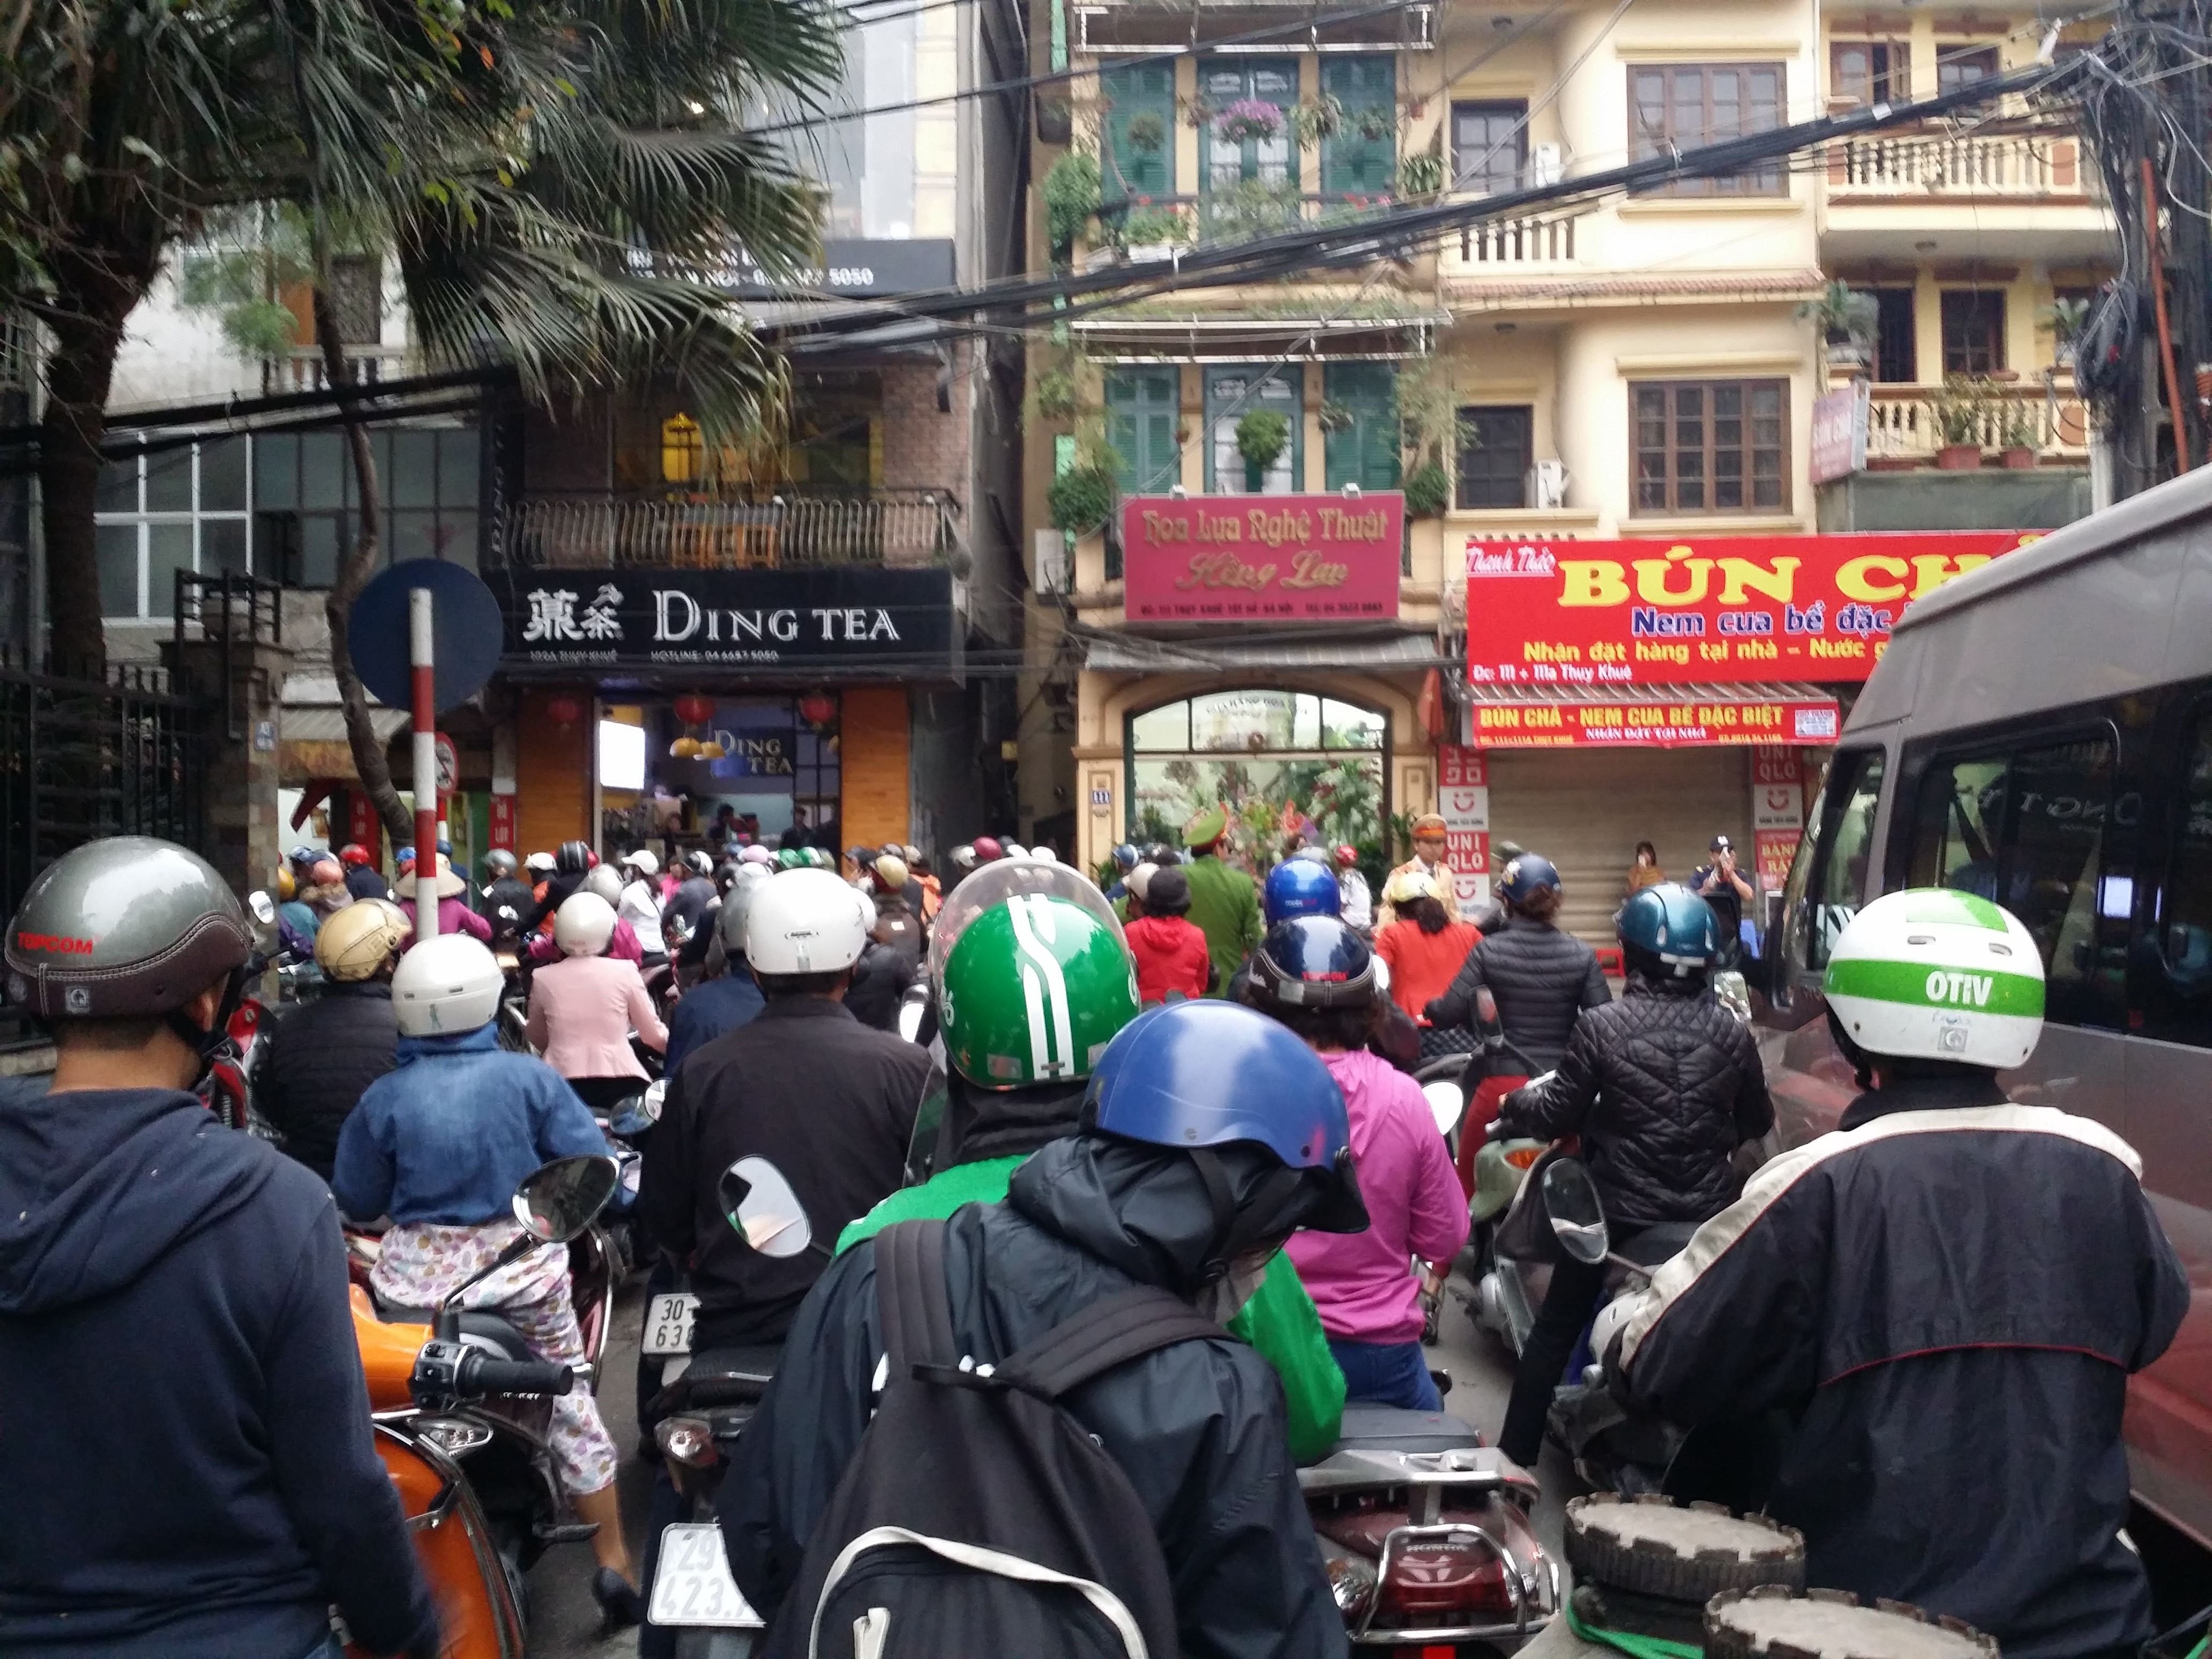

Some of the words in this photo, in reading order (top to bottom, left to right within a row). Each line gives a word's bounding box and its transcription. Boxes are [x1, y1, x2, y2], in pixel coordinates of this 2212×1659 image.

[1557, 545, 1802, 607] BÚN
[652, 589, 799, 642] DING
[812, 609, 901, 641] TEA
[1632, 607, 1706, 637] Nem
[1717, 611, 1774, 635] cua
[1784, 600, 1826, 635] bể
[1836, 602, 1893, 639] đặc
[1524, 641, 1580, 664] Nhận
[1589, 641, 1626, 664] đặt
[1635, 641, 1689, 665] hàng
[1699, 641, 1728, 664] tại
[1737, 639, 1778, 659] nhà
[1810, 638, 1866, 659] Nước
[1480, 705, 1520, 728] BÚN
[1580, 707, 1623, 727] NEM
[1627, 707, 1665, 727] CUA
[714, 729, 781, 757] DING
[747, 756, 794, 774] TEA
[1447, 834, 1480, 850] UNI
[1447, 851, 1483, 872] QLO
[678, 1531, 718, 1571] 29
